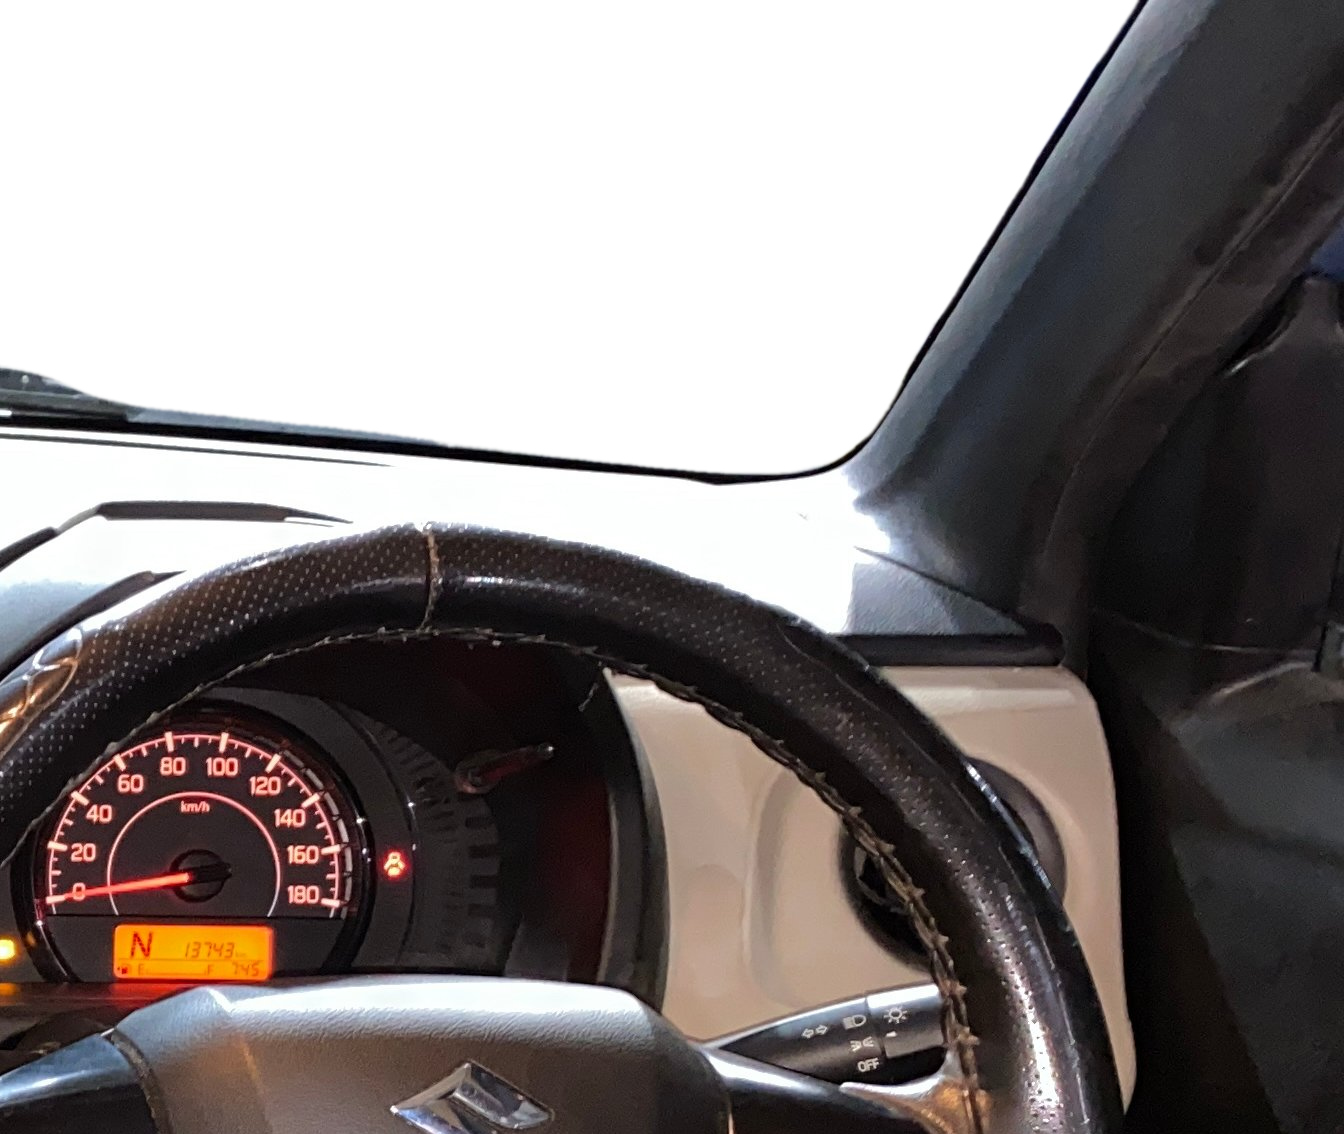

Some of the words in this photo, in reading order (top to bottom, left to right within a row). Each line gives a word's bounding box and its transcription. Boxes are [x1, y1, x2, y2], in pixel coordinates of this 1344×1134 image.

[161, 757, 186, 775] 80
[207, 757, 238, 776] 100
[117, 774, 144, 793] 60
[250, 776, 281, 795] 120
[86, 804, 112, 823] 40
[181, 800, 210, 813] km/h
[275, 808, 306, 827] 140
[71, 843, 96, 861] 20
[288, 845, 319, 863] 160
[72, 883, 86, 900] 0
[288, 885, 319, 903] 180
[130, 932, 153, 958] N
[184, 942, 236, 958] 13743
[857, 1057, 880, 1072] OFF
